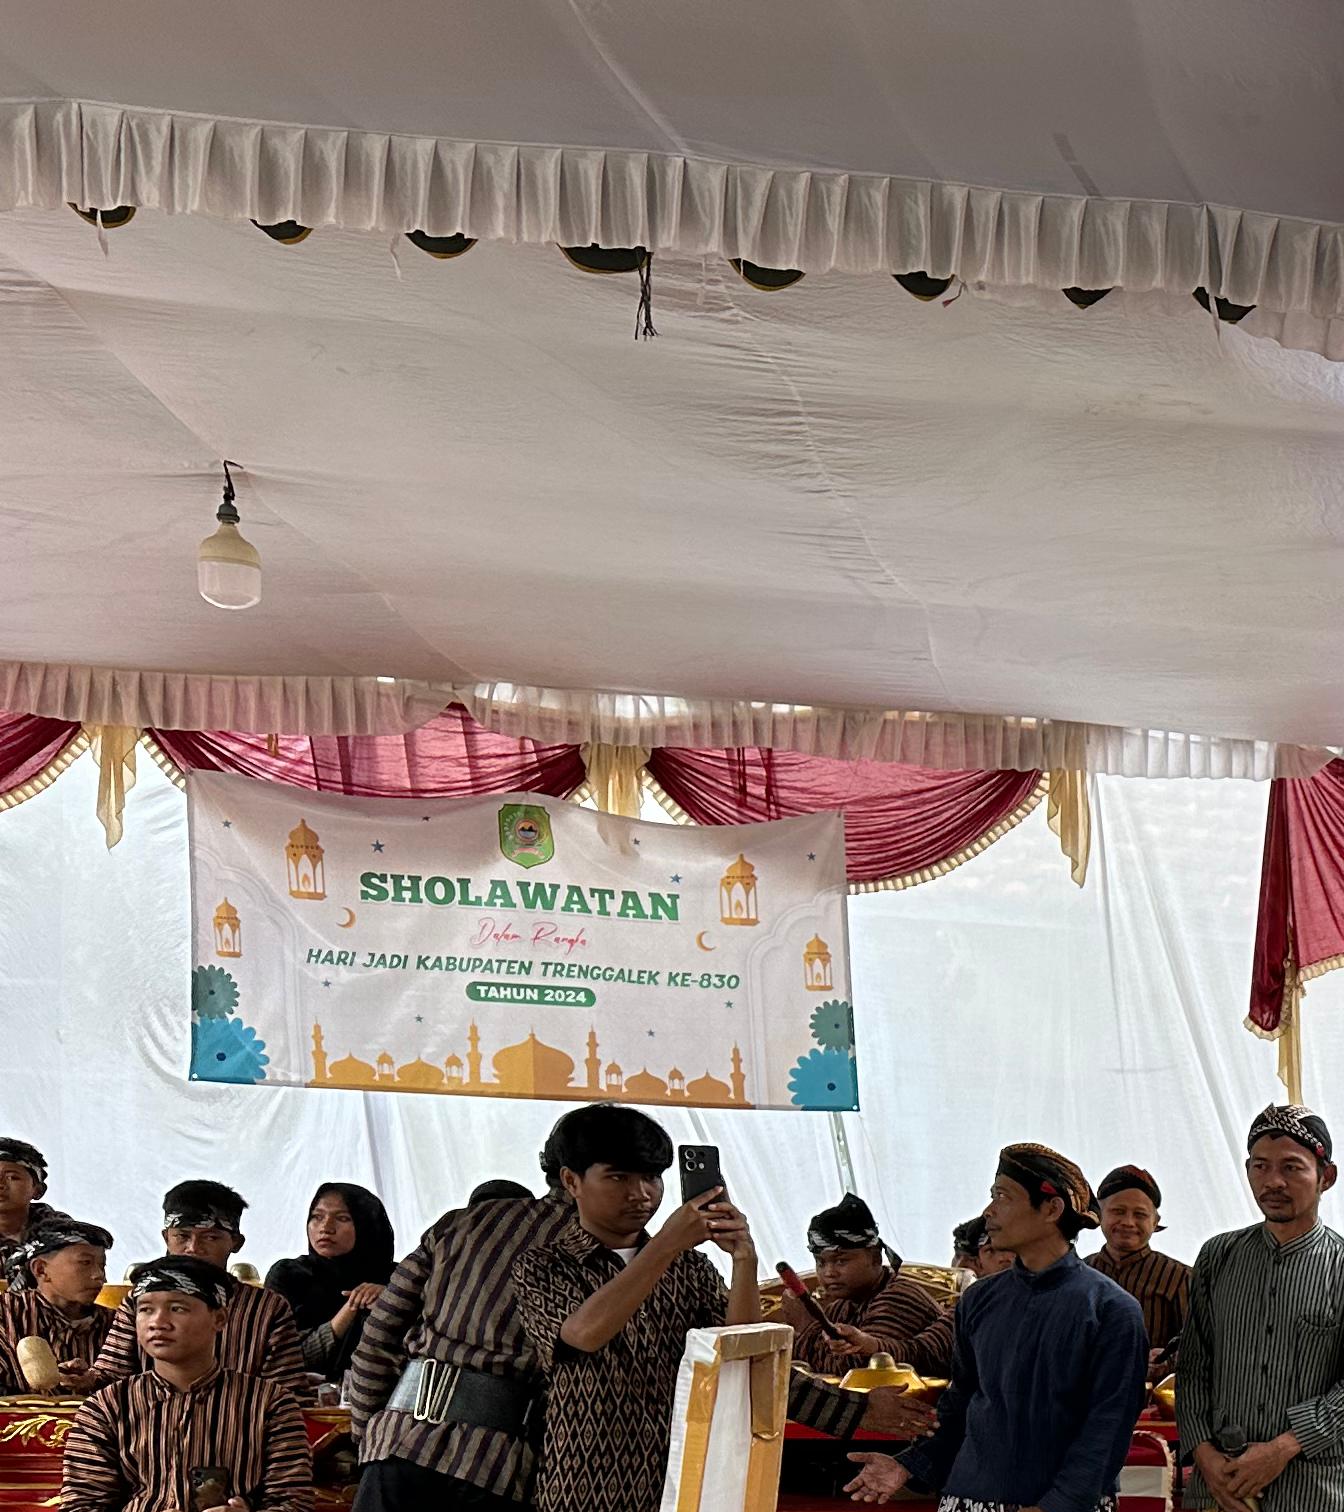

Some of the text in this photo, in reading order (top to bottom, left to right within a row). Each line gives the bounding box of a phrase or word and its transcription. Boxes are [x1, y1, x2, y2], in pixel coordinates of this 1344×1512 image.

[360, 872, 680, 921] SHOLAWATAN
[306, 949, 740, 989] HARI JADI KABUPATEN TRENGGALEK KE-830
[476, 985, 587, 1004] TAHUN 2024
